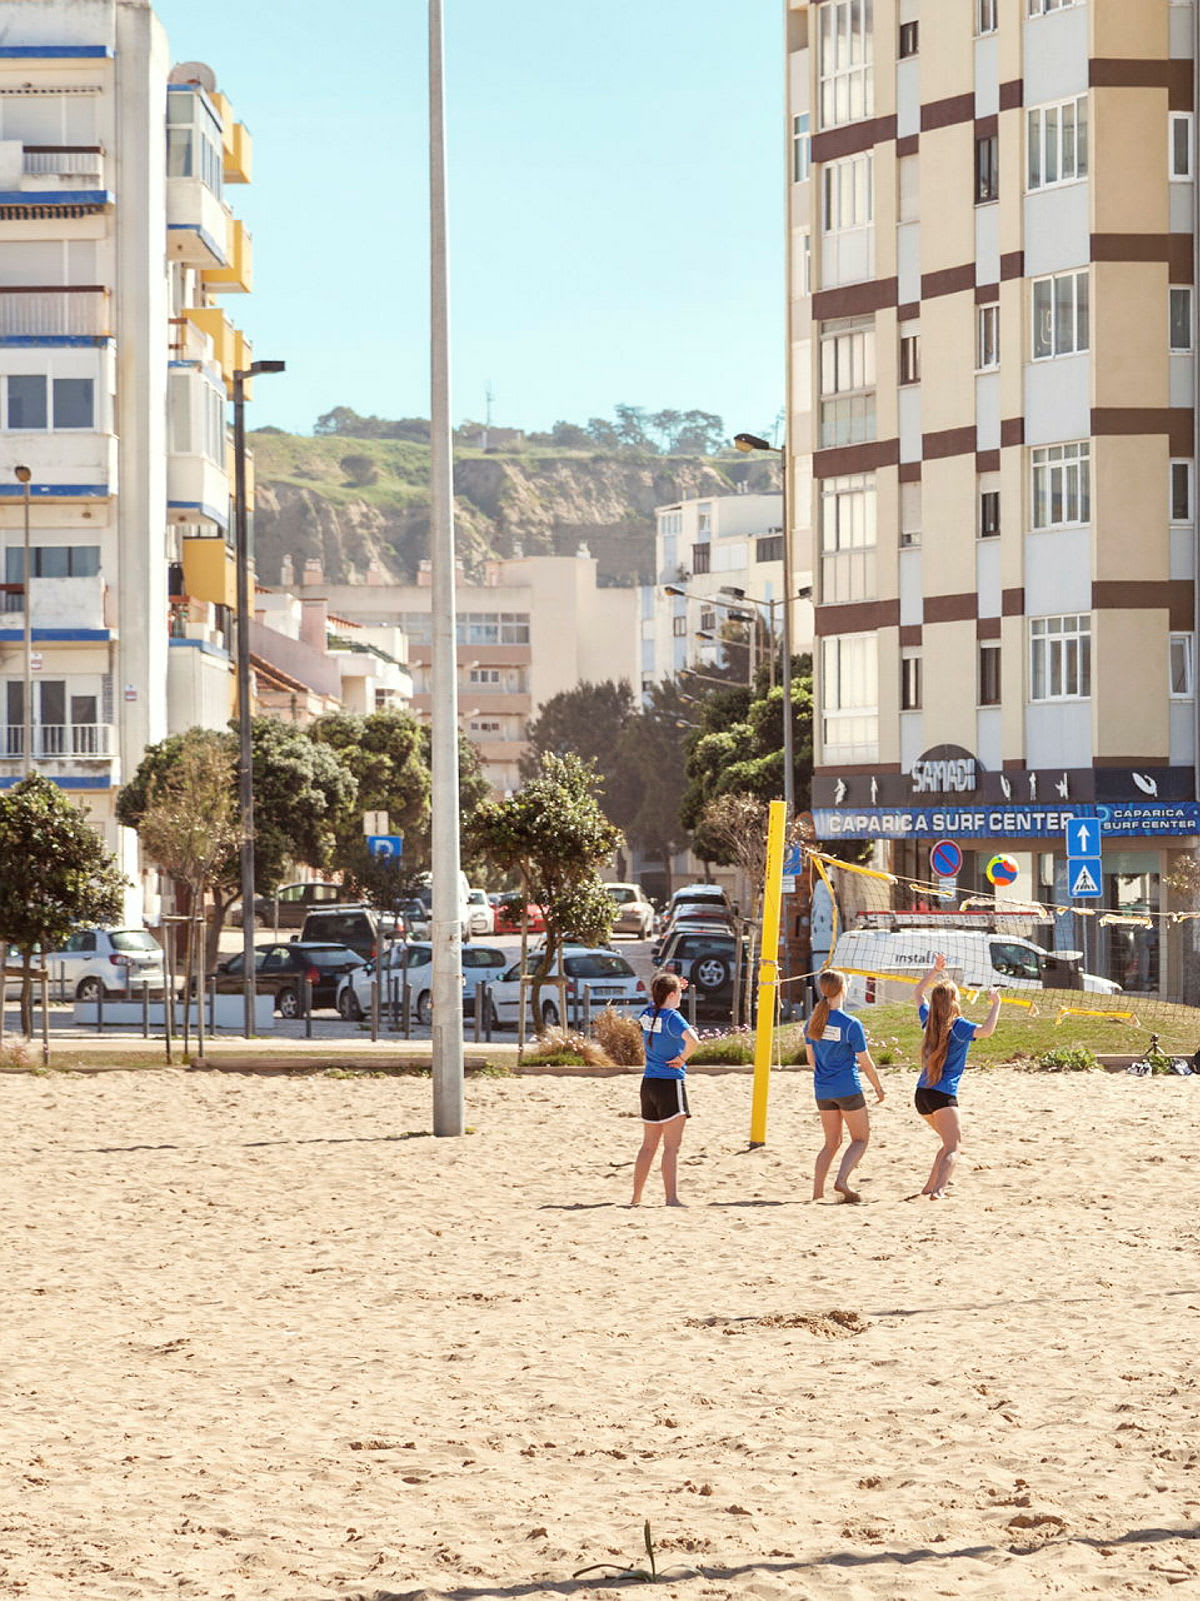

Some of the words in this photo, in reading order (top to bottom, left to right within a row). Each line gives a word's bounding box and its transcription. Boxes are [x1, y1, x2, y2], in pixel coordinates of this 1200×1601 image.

[1113, 809, 1184, 818] CAPARICA
[829, 814, 928, 833] CAPARICA
[932, 813, 985, 831] SURF
[1103, 821, 1139, 830] SURF
[1142, 820, 1196, 829] CENTER
